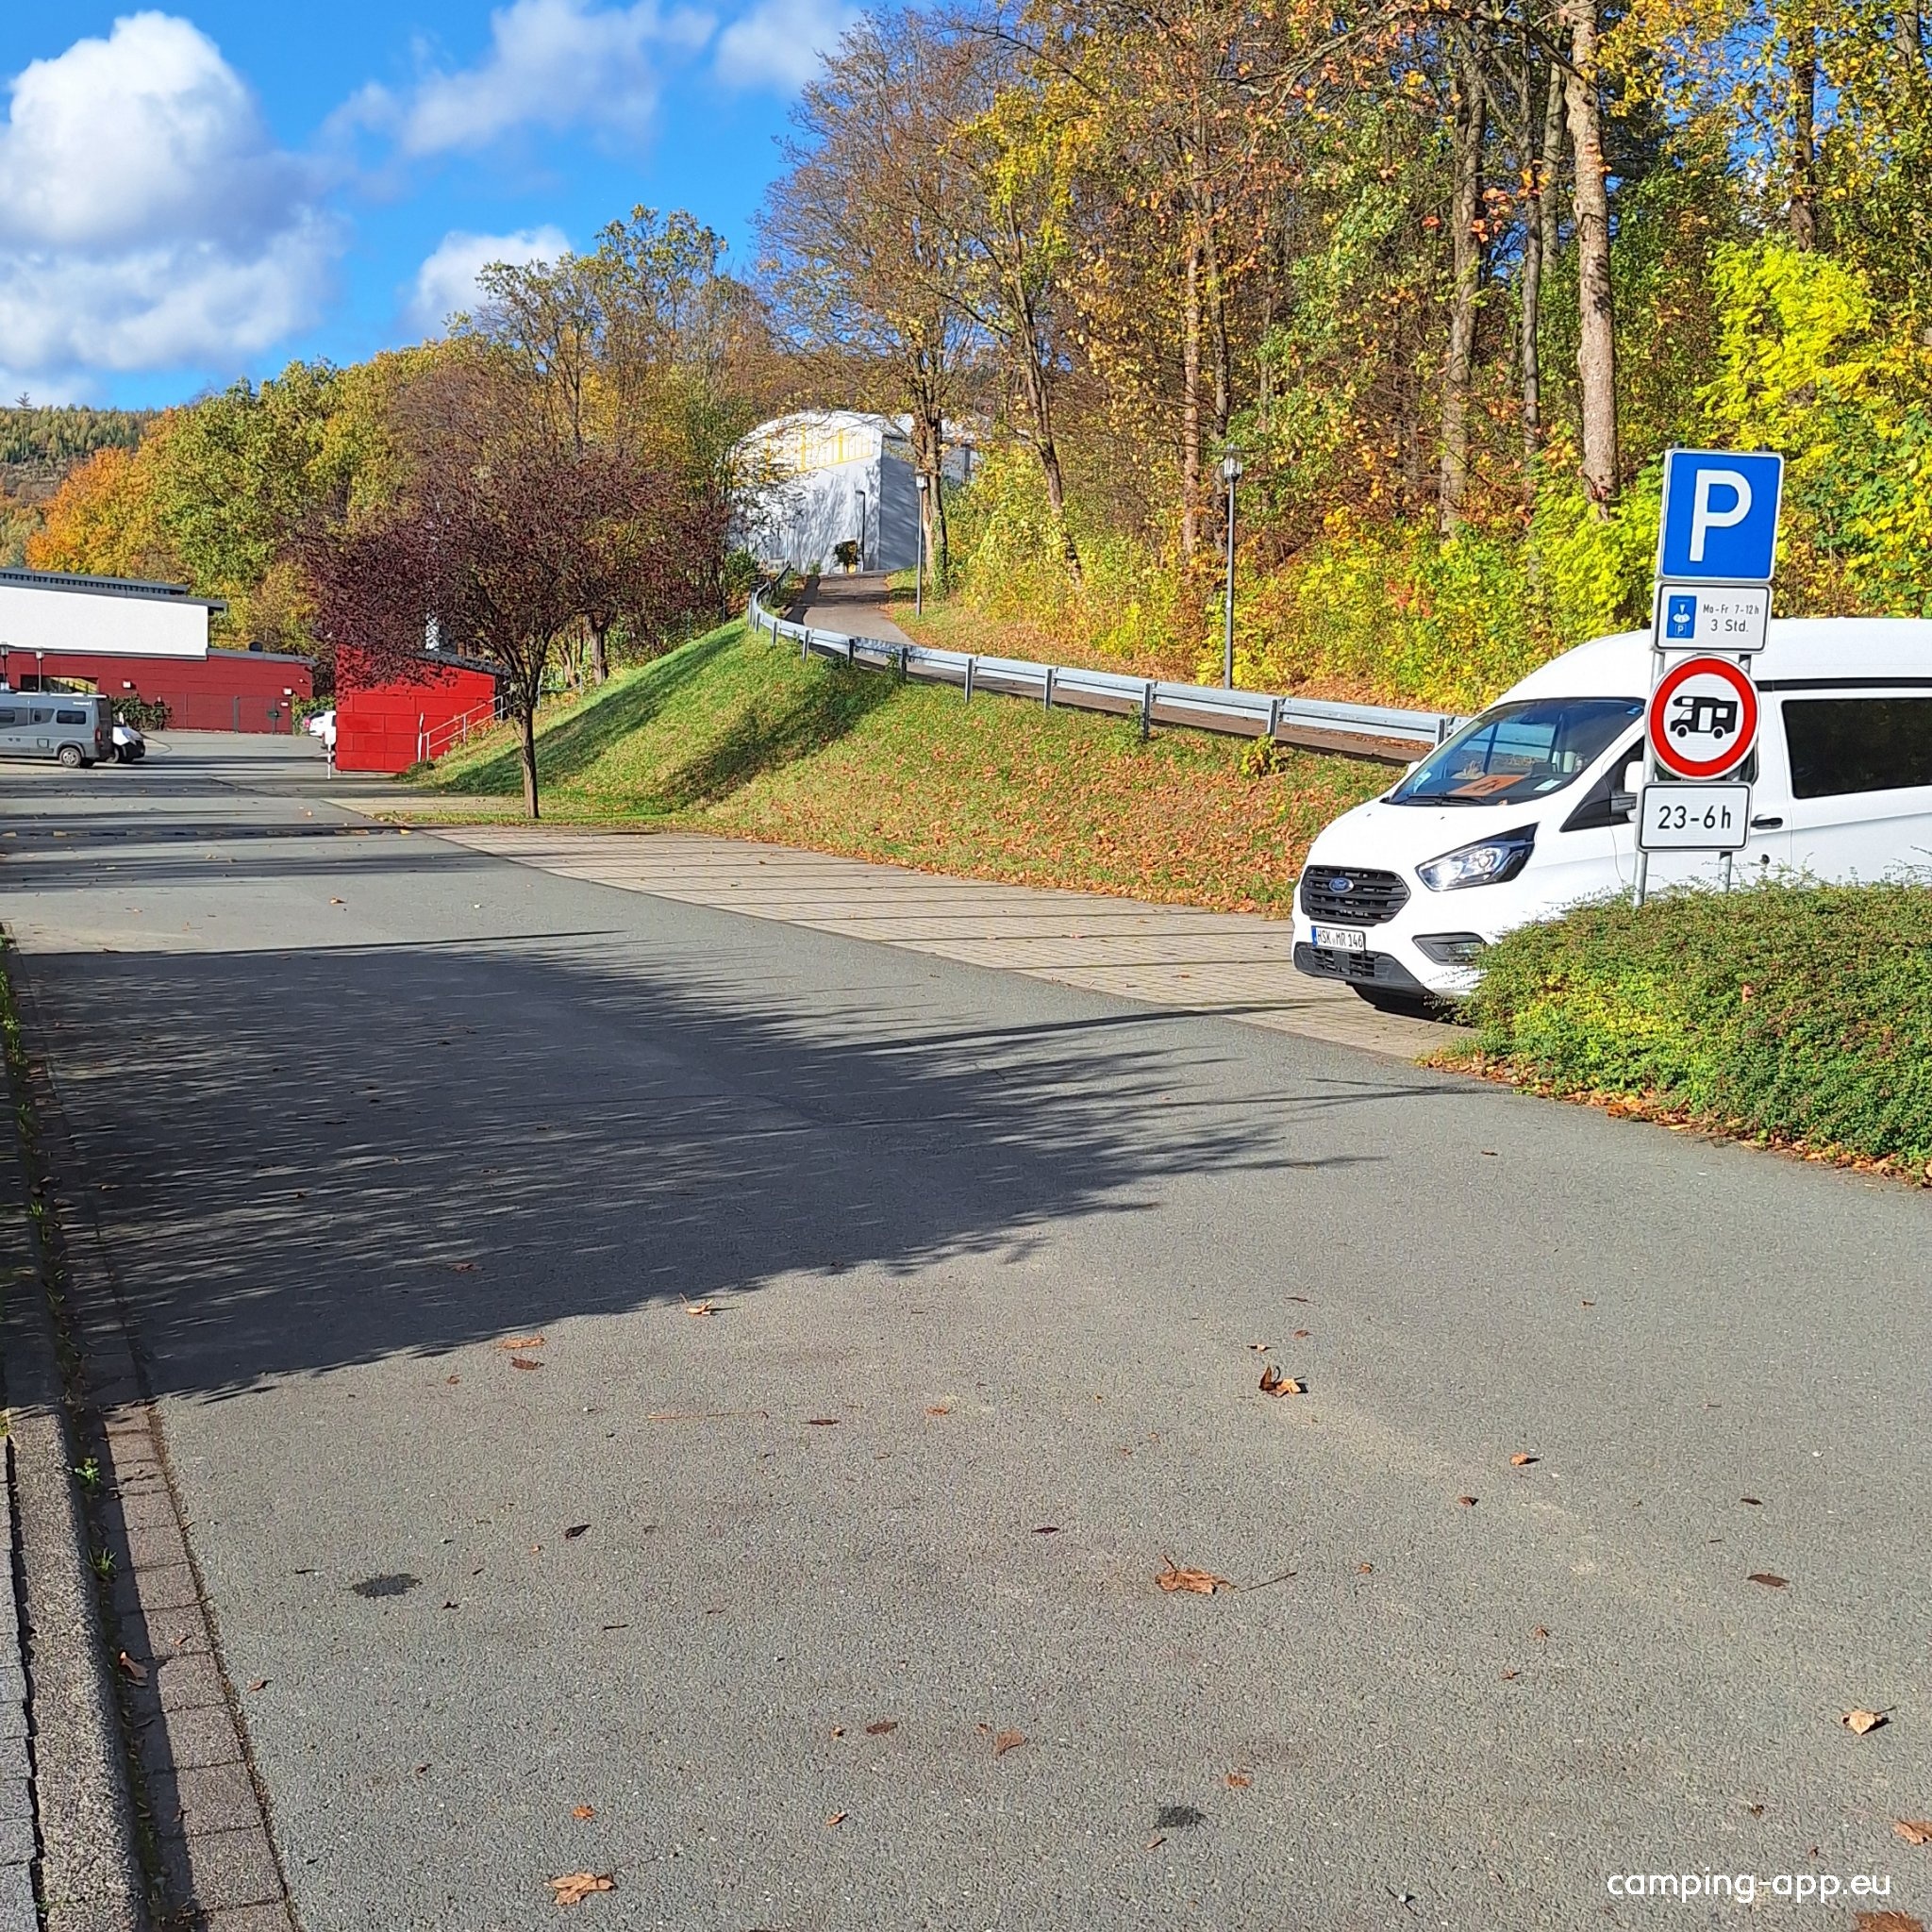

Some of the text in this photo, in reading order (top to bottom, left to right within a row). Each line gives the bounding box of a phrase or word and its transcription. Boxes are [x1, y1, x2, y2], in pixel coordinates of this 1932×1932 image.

[1690, 469, 1753, 562] P
[1677, 625, 1684, 634] P
[1710, 619, 1749, 633] 3 Std.
[1317, 929, 1363, 948] HSK MR 146
